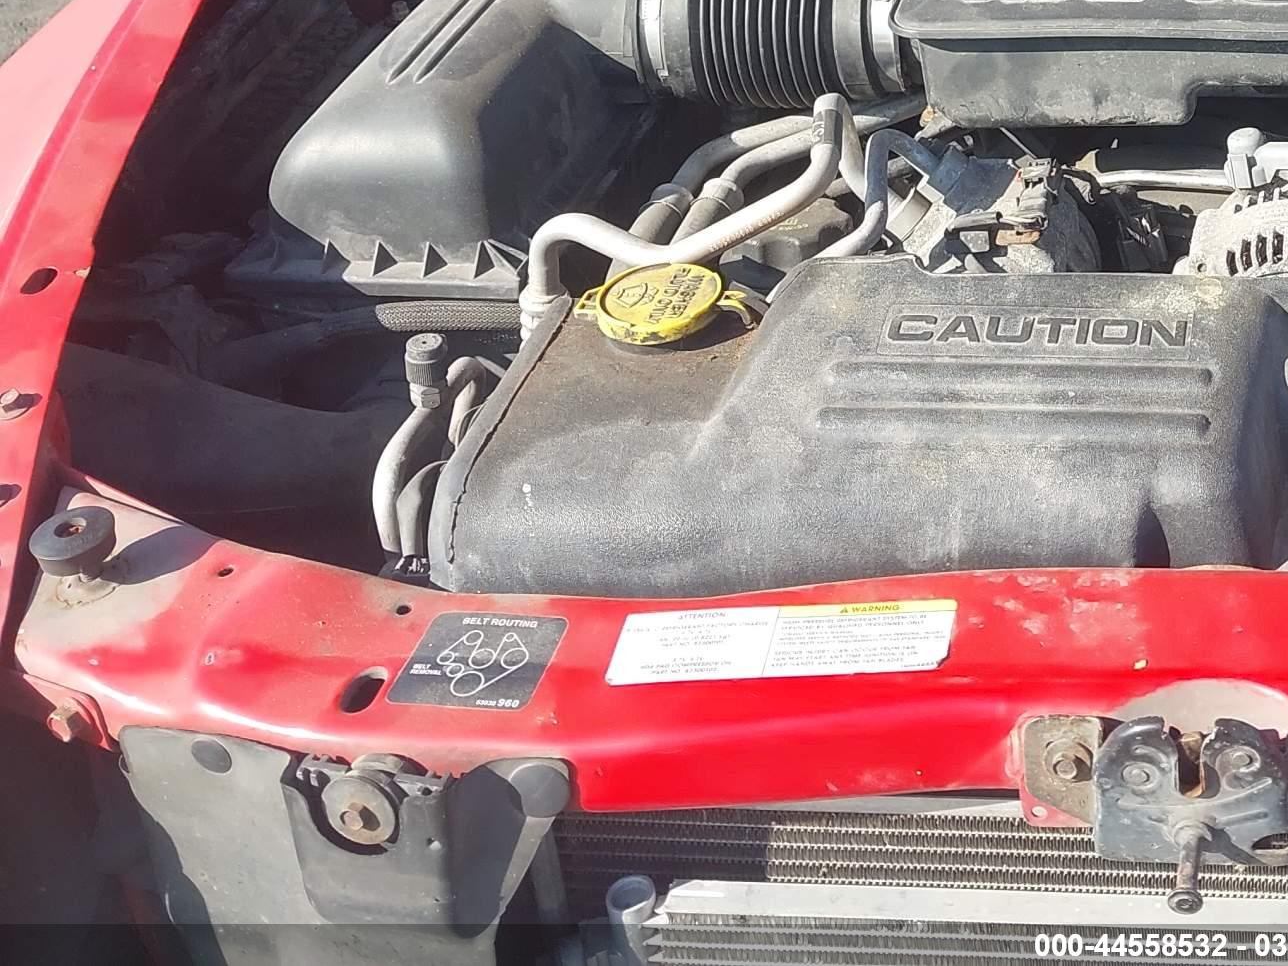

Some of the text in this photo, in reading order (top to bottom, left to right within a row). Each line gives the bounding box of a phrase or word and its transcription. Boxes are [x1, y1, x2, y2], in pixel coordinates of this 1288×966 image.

[887, 314, 1190, 347] CAUTION
[851, 603, 901, 613] WARNING
[678, 611, 727, 620] ATTENTION
[462, 617, 538, 629] BELT ROUTING
[409, 668, 442, 676] REMOVAL
[497, 698, 520, 708] 960
